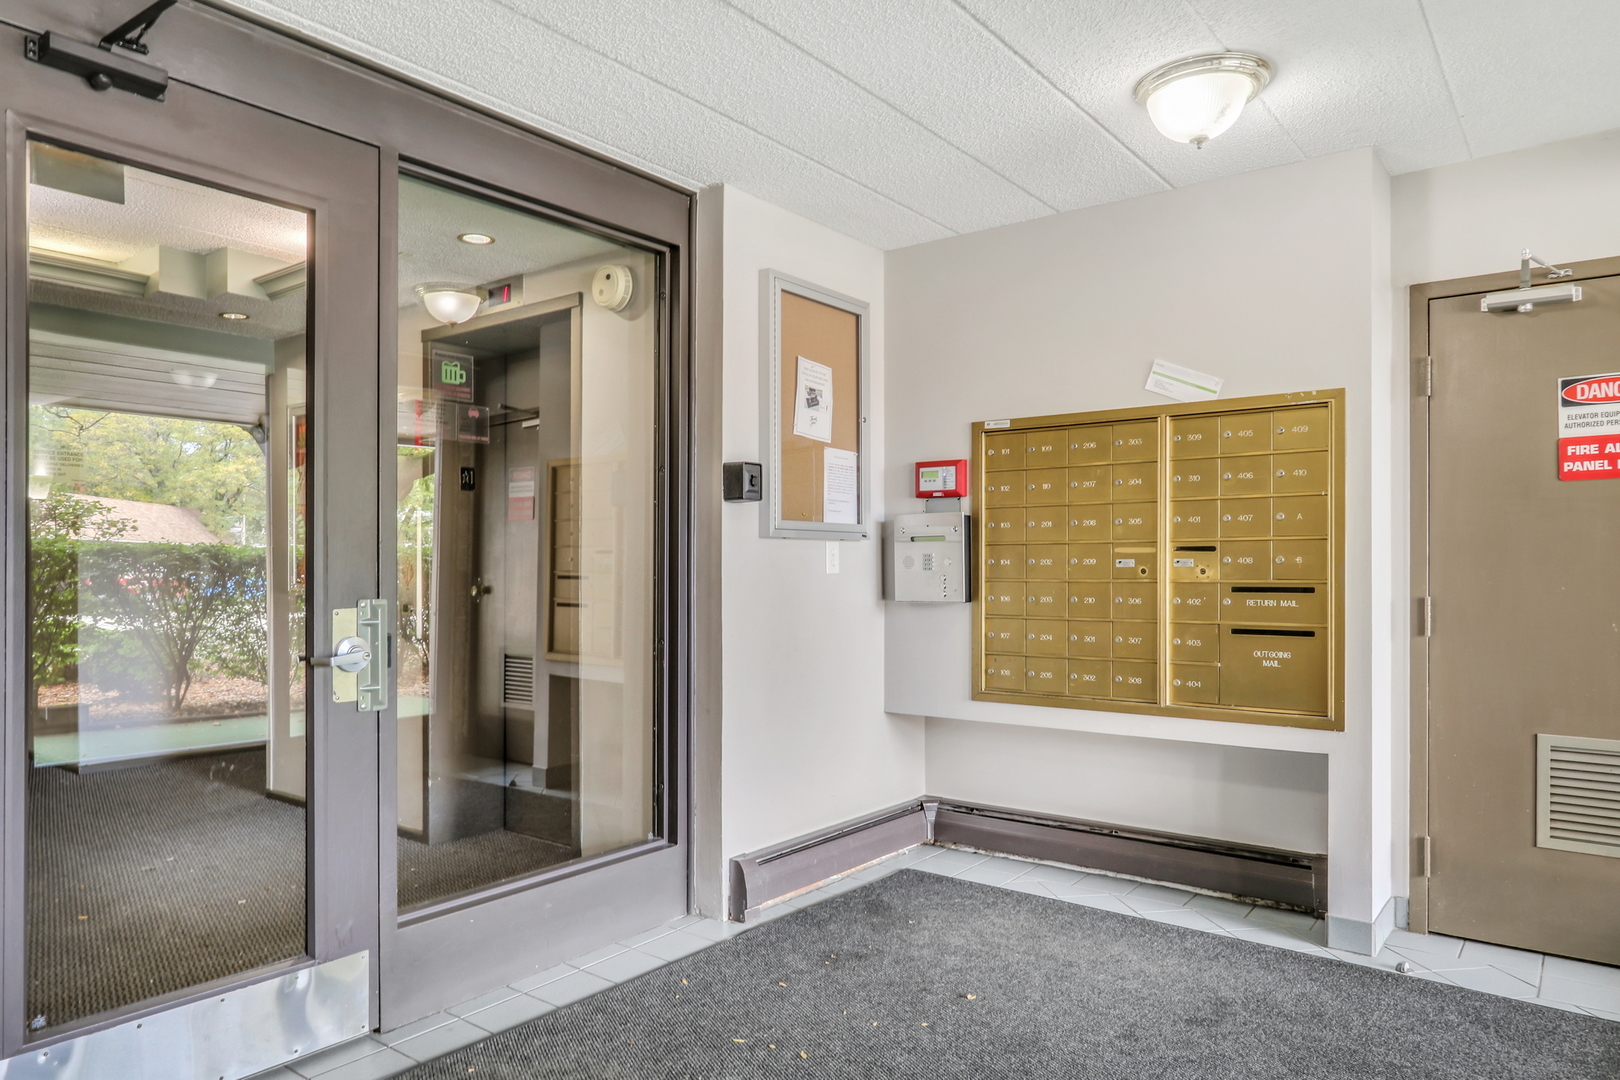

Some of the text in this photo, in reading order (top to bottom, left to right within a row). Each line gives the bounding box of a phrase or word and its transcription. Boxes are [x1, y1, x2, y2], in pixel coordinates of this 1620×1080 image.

[1567, 412, 1599, 421] ELEVATOR
[1564, 420, 1604, 429] AUTHORIZED
[1237, 429, 1254, 437] 405
[1291, 425, 1309, 433] 409
[1187, 433, 1203, 441] 309
[1082, 441, 1097, 449] 206
[1128, 438, 1143, 446] 303
[1567, 444, 1599, 456] FIRE
[1563, 460, 1613, 472] PANEL
[1237, 471, 1254, 479] 406
[1292, 468, 1308, 477] 410
[1128, 478, 1142, 486] 304
[1188, 474, 1201, 482] 310
[1082, 480, 1097, 488] 207
[1128, 517, 1143, 525] 305
[1187, 515, 1201, 523] 401
[1237, 514, 1254, 522] 407
[1040, 520, 1053, 528] 201
[1039, 558, 1053, 566] 202
[1127, 597, 1142, 605] 306
[1186, 598, 1202, 606] 402
[1246, 599, 1299, 608] RETURN MAIL
[1083, 635, 1096, 643] 301
[1186, 639, 1202, 647] 403
[1253, 650, 1292, 659] OUTGOING
[1262, 659, 1281, 668] MAIL
[1039, 671, 1053, 679] 205
[1082, 674, 1096, 682] 302
[1186, 680, 1202, 688] 404
